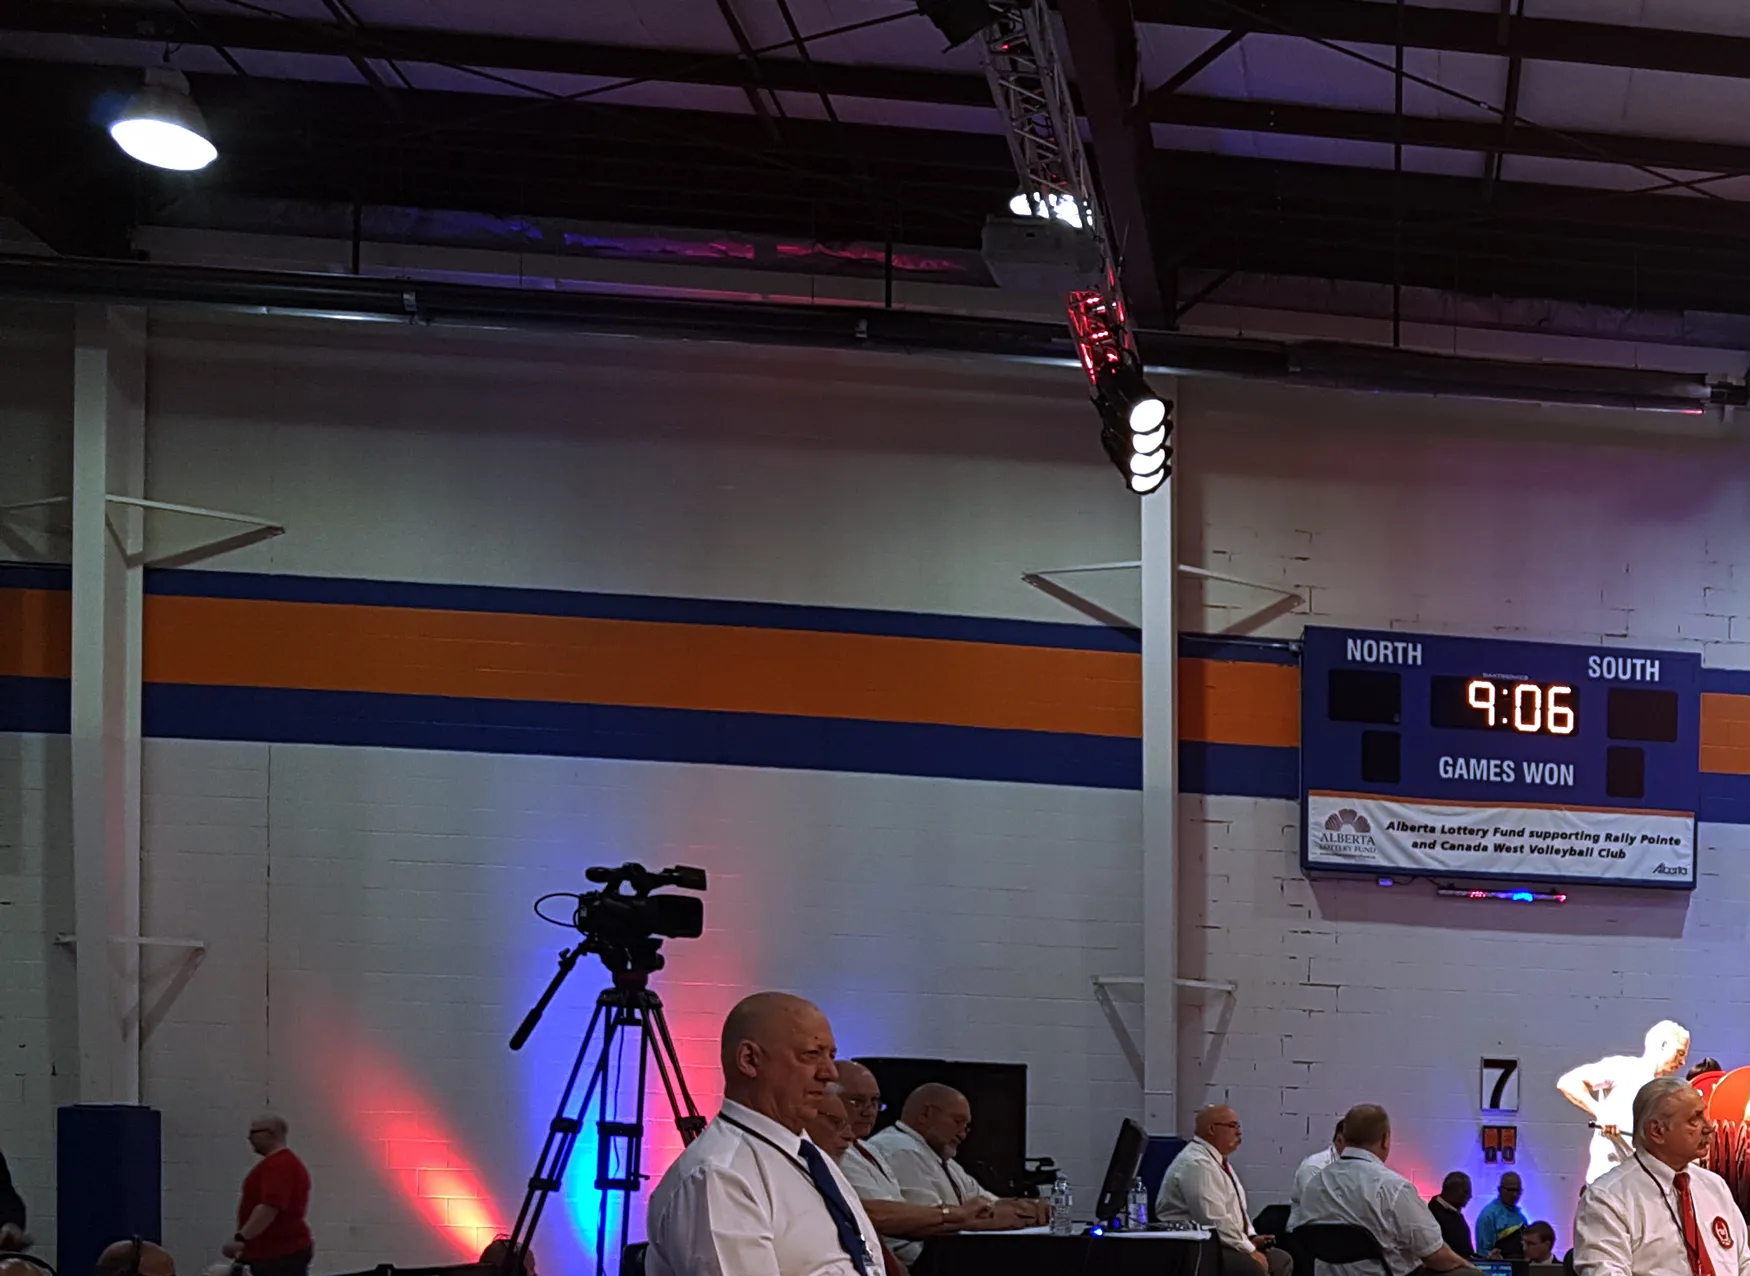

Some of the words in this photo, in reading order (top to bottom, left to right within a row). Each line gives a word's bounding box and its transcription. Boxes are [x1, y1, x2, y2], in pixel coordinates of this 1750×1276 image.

[1347, 637, 1423, 666] NORTH
[1588, 655, 1660, 683] SOUTH
[1467, 680, 1575, 735] 9:06
[1438, 755, 1516, 784] GAMES
[1523, 760, 1575, 787] WON
[1319, 832, 1376, 846] ALBERTA
[1385, 820, 1437, 834] Alberta
[1440, 823, 1489, 839] Lottery
[1492, 826, 1526, 838] Fund
[1529, 830, 1601, 844] supporting
[1604, 832, 1637, 846] Rally
[1640, 834, 1681, 846] Pointe
[1353, 845, 1376, 853] FUND
[1411, 839, 1437, 850] and
[1440, 840, 1489, 852] Canada
[1492, 843, 1525, 854] West
[1529, 844, 1594, 858] Volleyball
[1598, 848, 1626, 859] Club
[1483, 1058, 1518, 1110] 7
